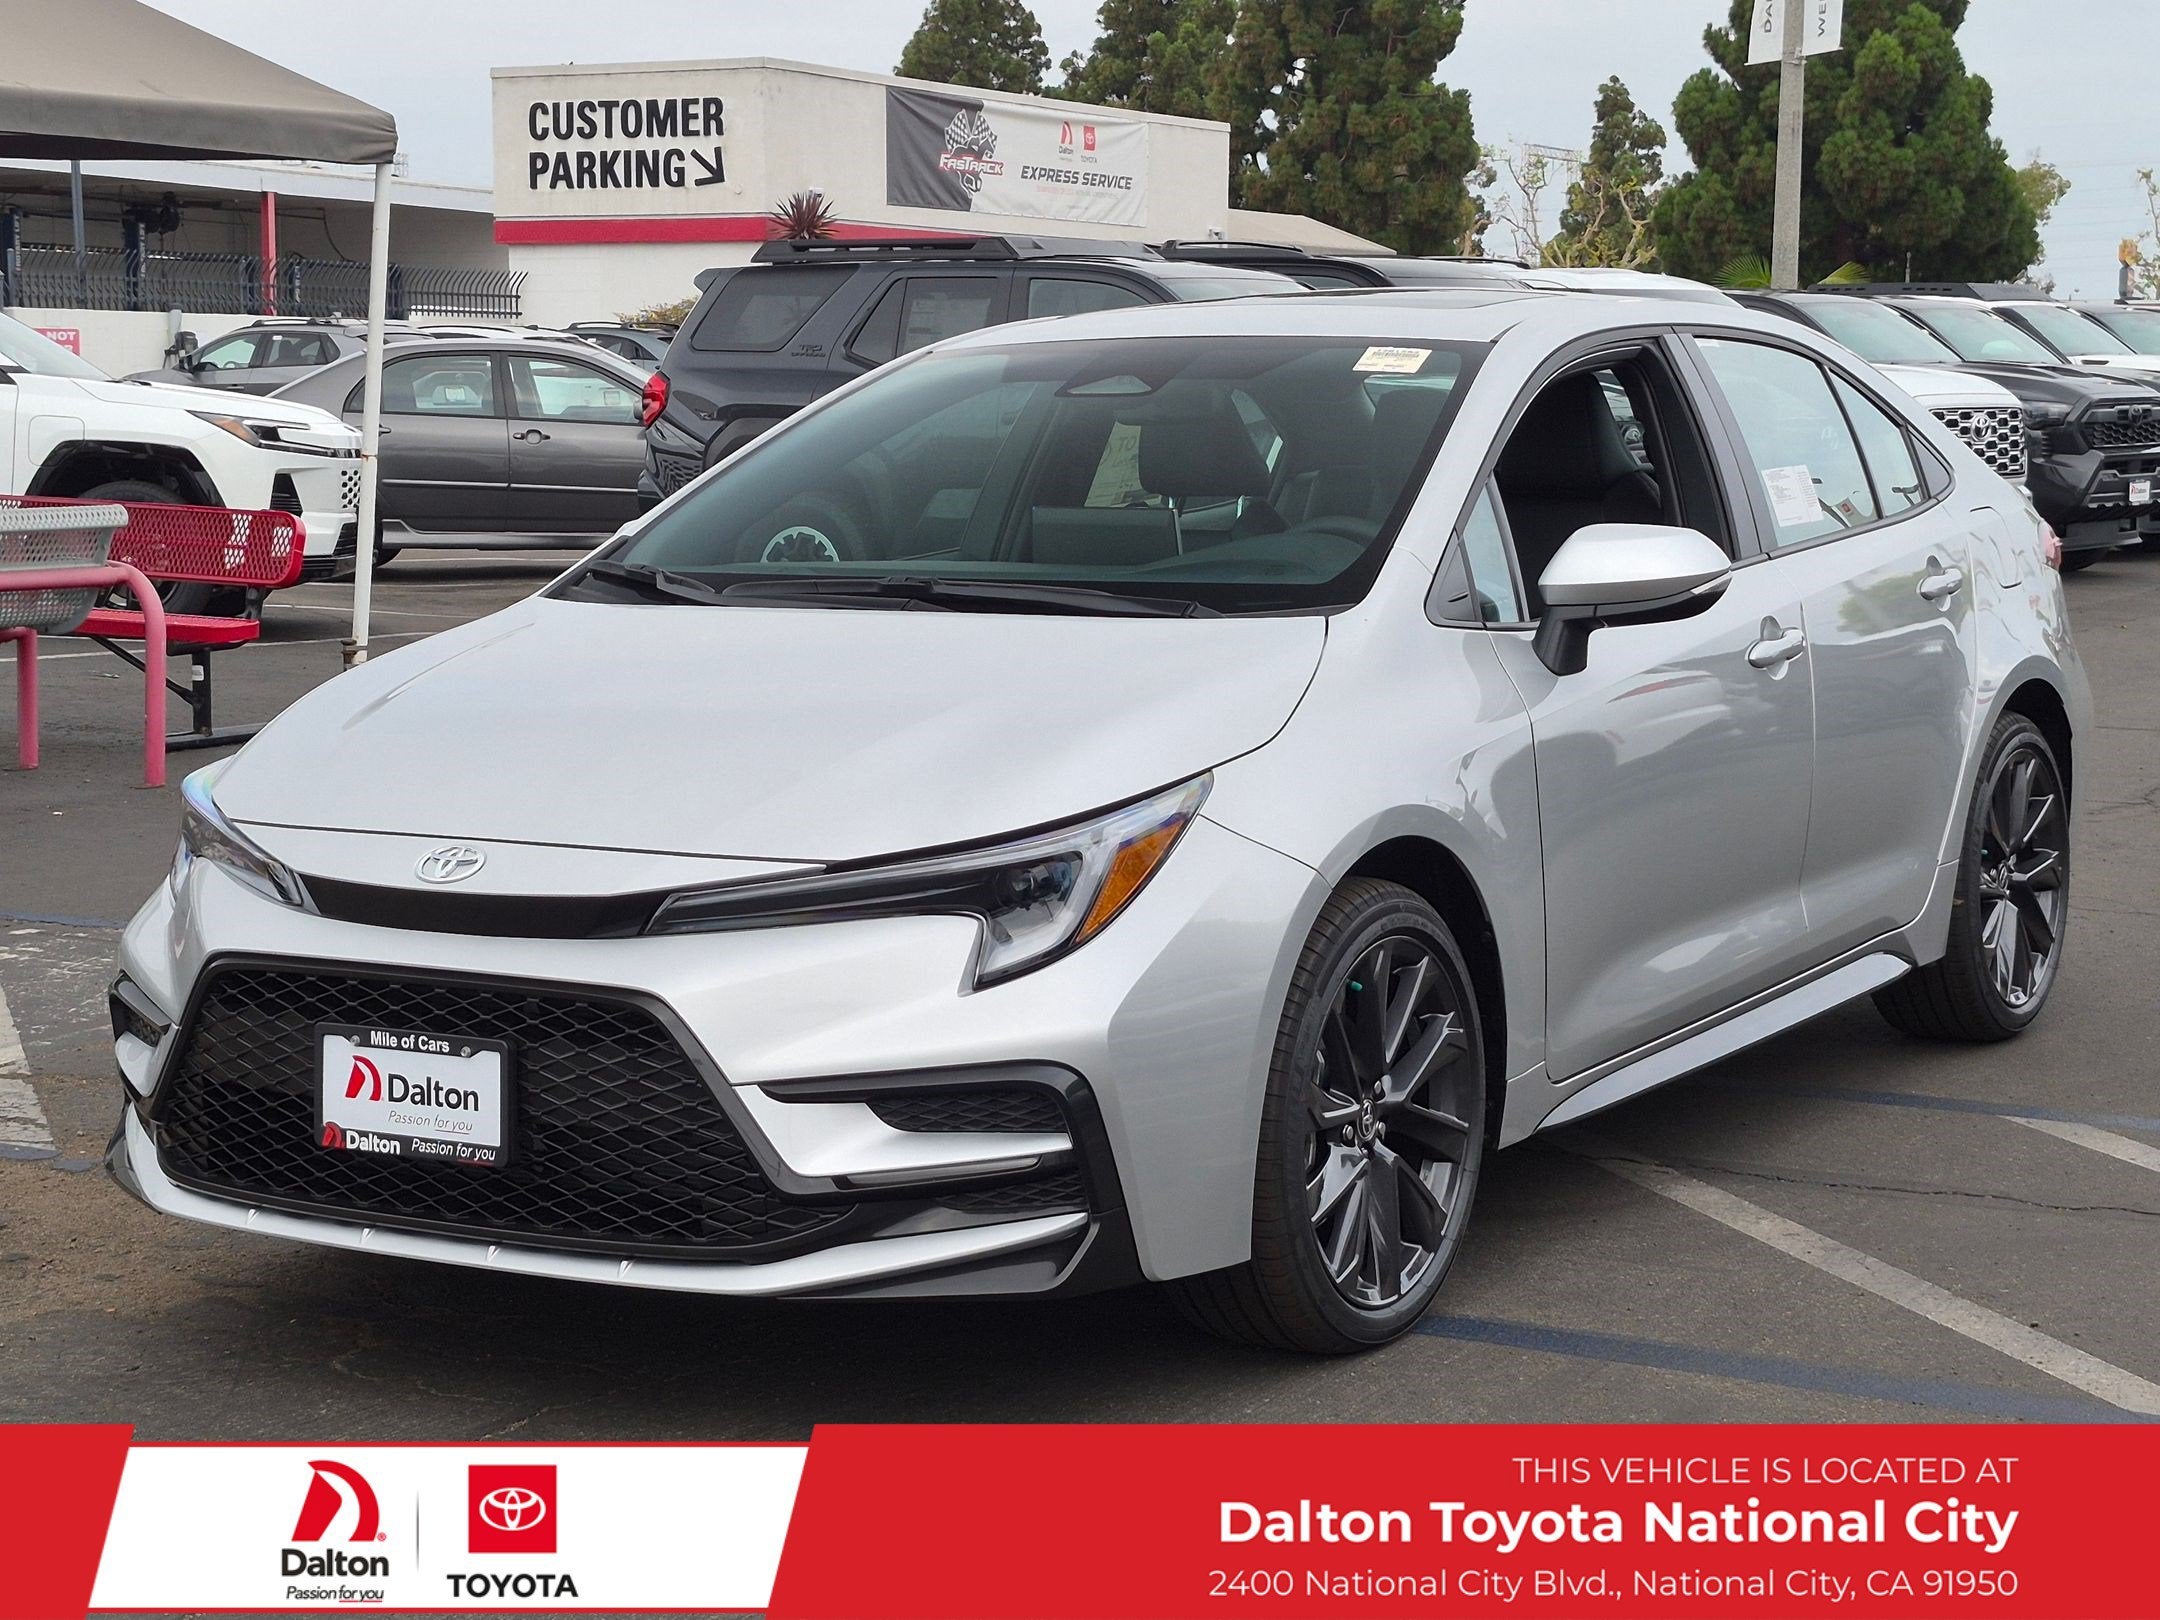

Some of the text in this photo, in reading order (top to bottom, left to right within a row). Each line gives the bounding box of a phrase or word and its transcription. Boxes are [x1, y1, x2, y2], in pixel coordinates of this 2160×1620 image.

[1764, 0, 1773, 33] DA
[1818, 0, 1827, 37] WE
[529, 97, 725, 141] CUSTOMER
[529, 148, 686, 190] PARKING
[1020, 165, 1133, 190] EXPRESS SERVICE
[46, 331, 76, 341] NOT
[370, 1031, 450, 1053] Mile of Cars
[388, 1073, 479, 1111] Dalton
[388, 1110, 473, 1132] Passion for you
[346, 1130, 400, 1155] Dalton
[411, 1138, 496, 1161] Passion for you
